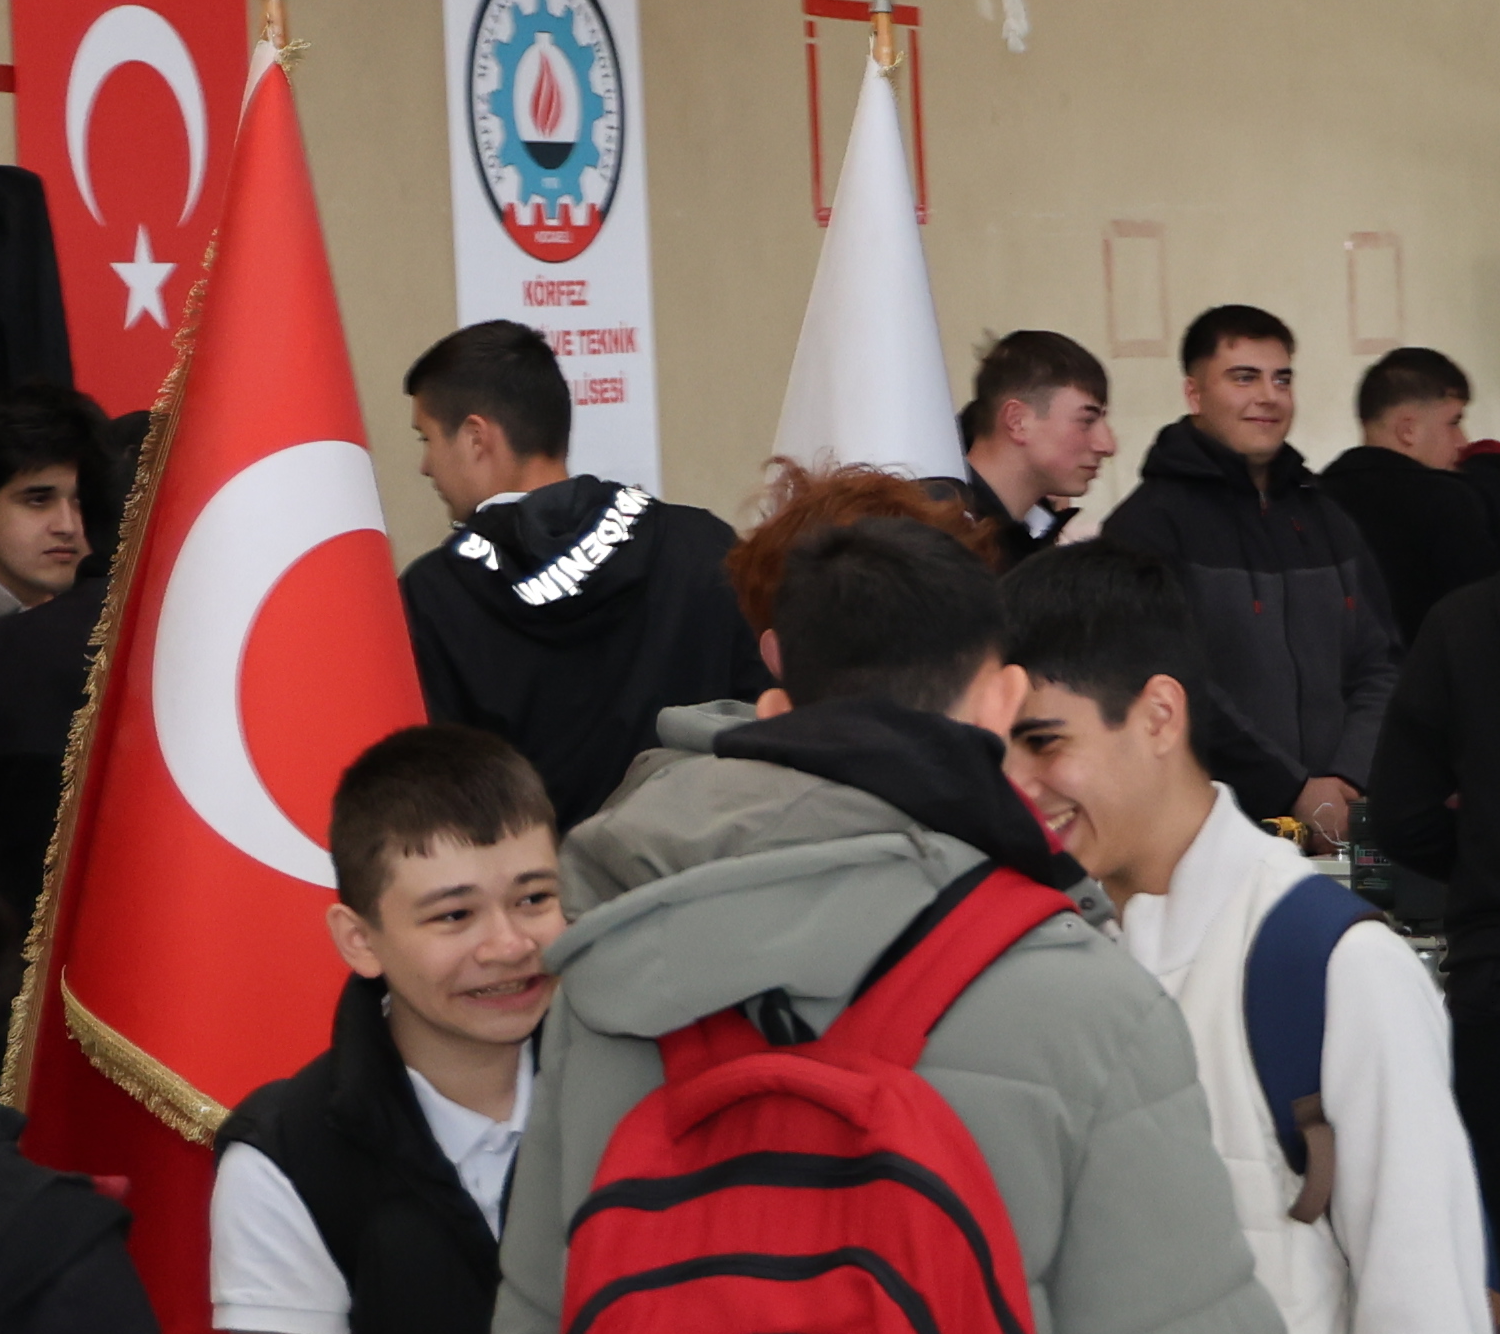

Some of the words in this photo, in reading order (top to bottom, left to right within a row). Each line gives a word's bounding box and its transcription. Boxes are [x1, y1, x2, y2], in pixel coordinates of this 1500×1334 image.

[522, 275, 589, 306] KÖRFEZ
[577, 321, 638, 355] TEKNİK
[573, 370, 628, 406] LİSESİ
